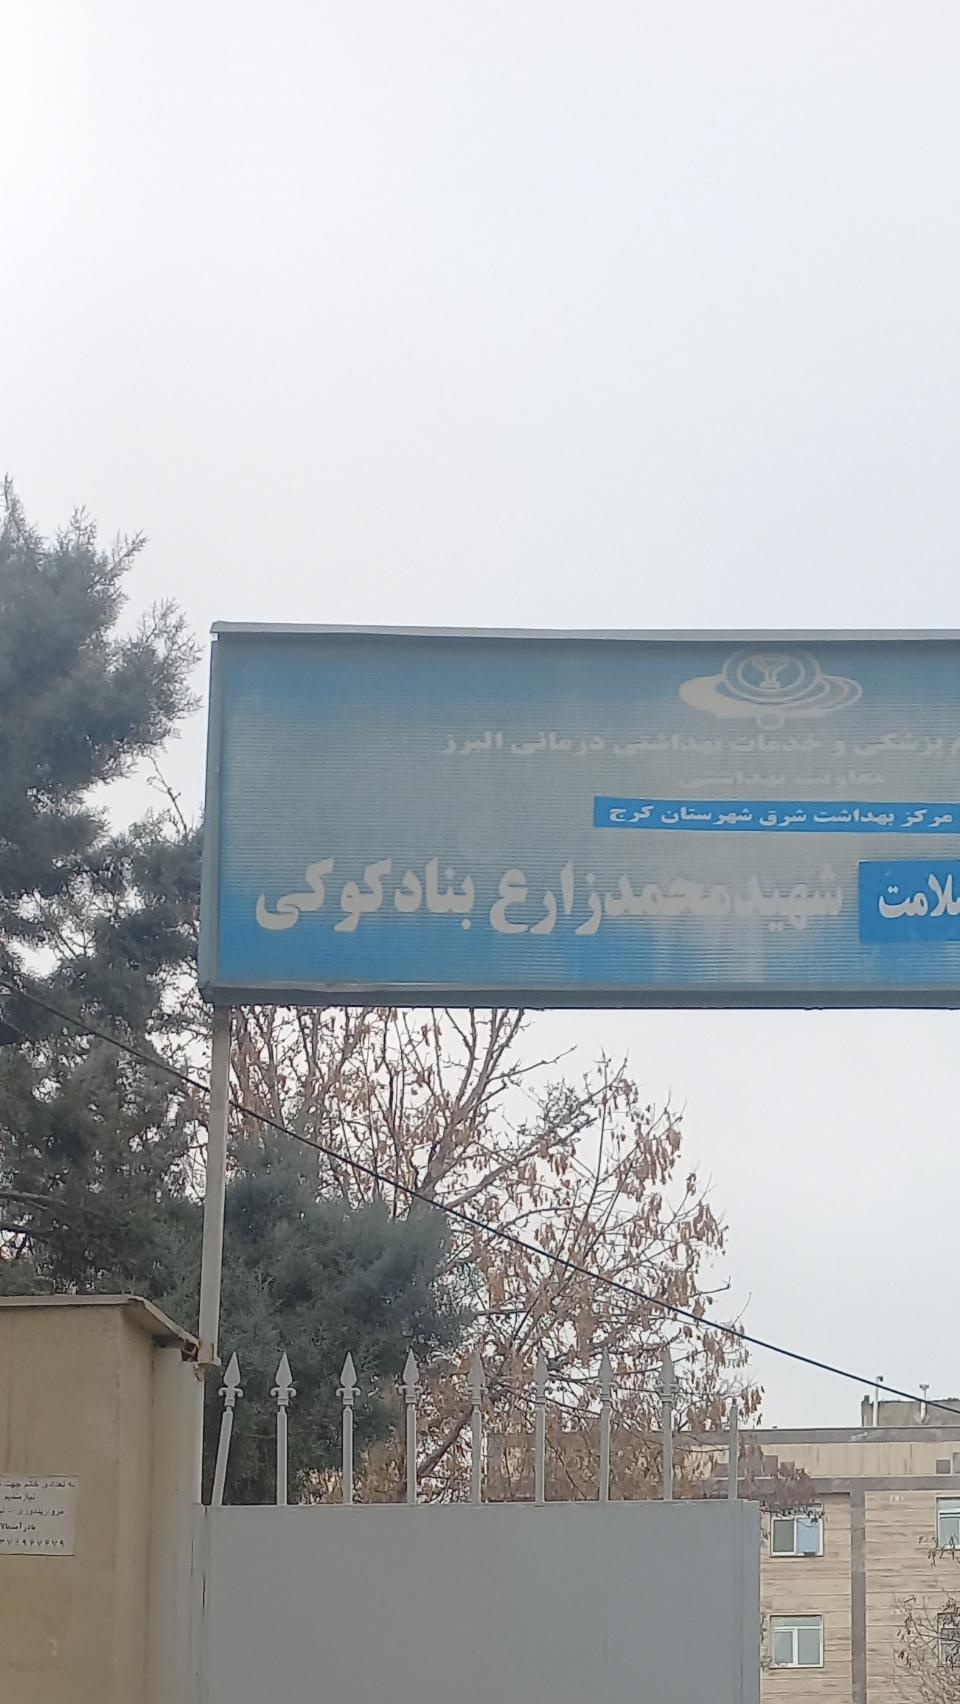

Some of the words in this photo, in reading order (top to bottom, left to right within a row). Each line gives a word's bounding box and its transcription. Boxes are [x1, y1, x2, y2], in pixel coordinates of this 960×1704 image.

[442, 731, 503, 755] البرز
[511, 732, 607, 756] درمانی
[613, 733, 720, 756] بهداشتی
[730, 733, 825, 753] خدمات
[831, 741, 847, 757] و
[854, 732, 944, 757] پزشکی
[608, 805, 655, 823] کرج
[660, 805, 753, 826] شهرستان
[759, 808, 807, 827] شرق
[813, 808, 896, 827] بهداشت
[902, 809, 954, 828] مرکز
